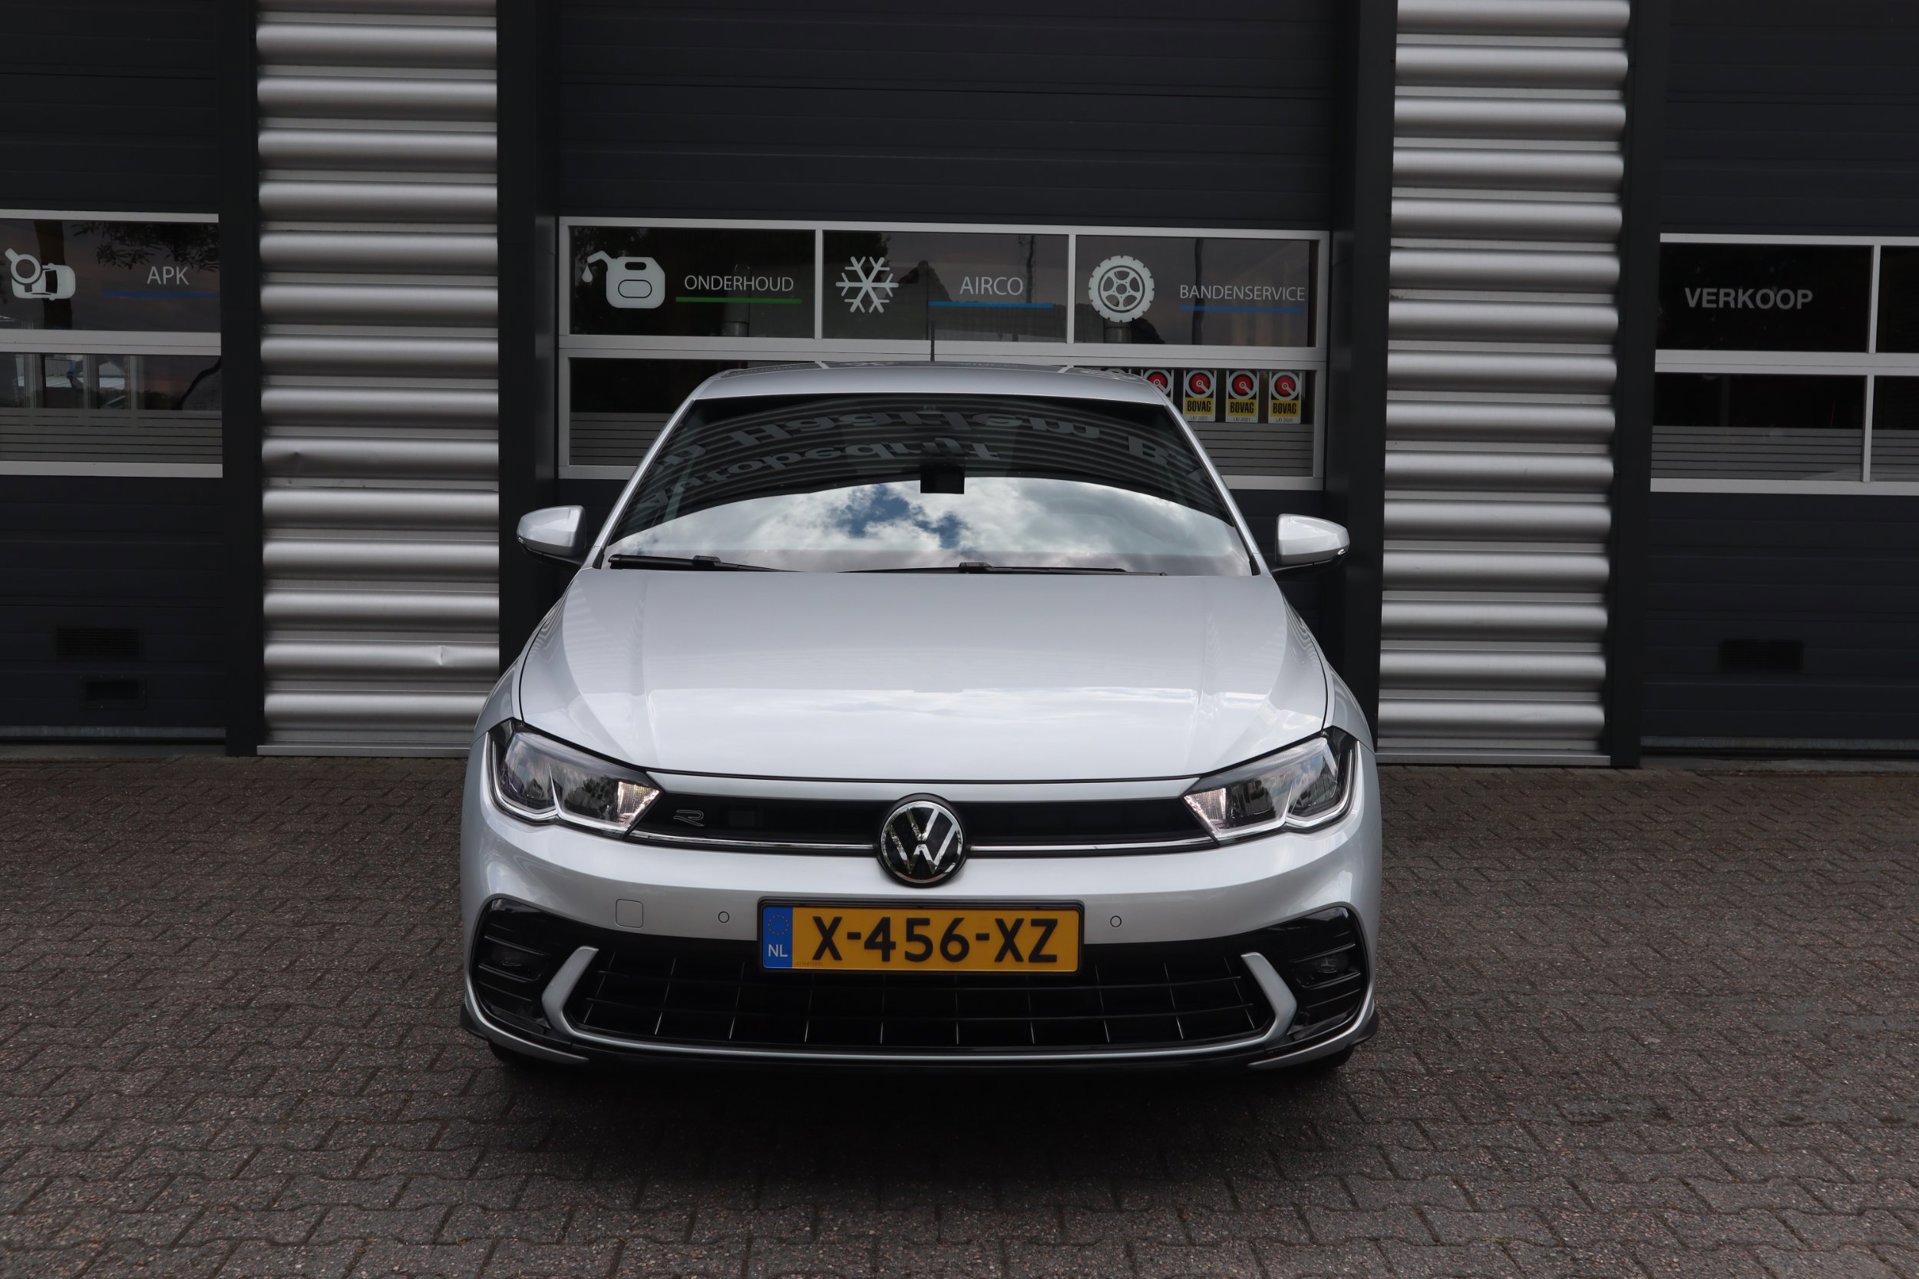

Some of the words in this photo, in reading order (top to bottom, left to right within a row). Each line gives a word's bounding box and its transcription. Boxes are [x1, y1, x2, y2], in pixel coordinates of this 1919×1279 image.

[146, 265, 190, 286] APK
[684, 274, 794, 293] ONDERHOUD
[959, 275, 1024, 297] AIRCO
[1179, 284, 1306, 302] BANDENSERVICE
[1684, 287, 1814, 310] VERKOOP
[1187, 400, 1212, 412] BOVAG
[1229, 401, 1255, 414] BOVAG
[1272, 402, 1297, 415] BOVAG
[812, 915, 1059, 964] X-456-XZ
[768, 944, 788, 958] NL
